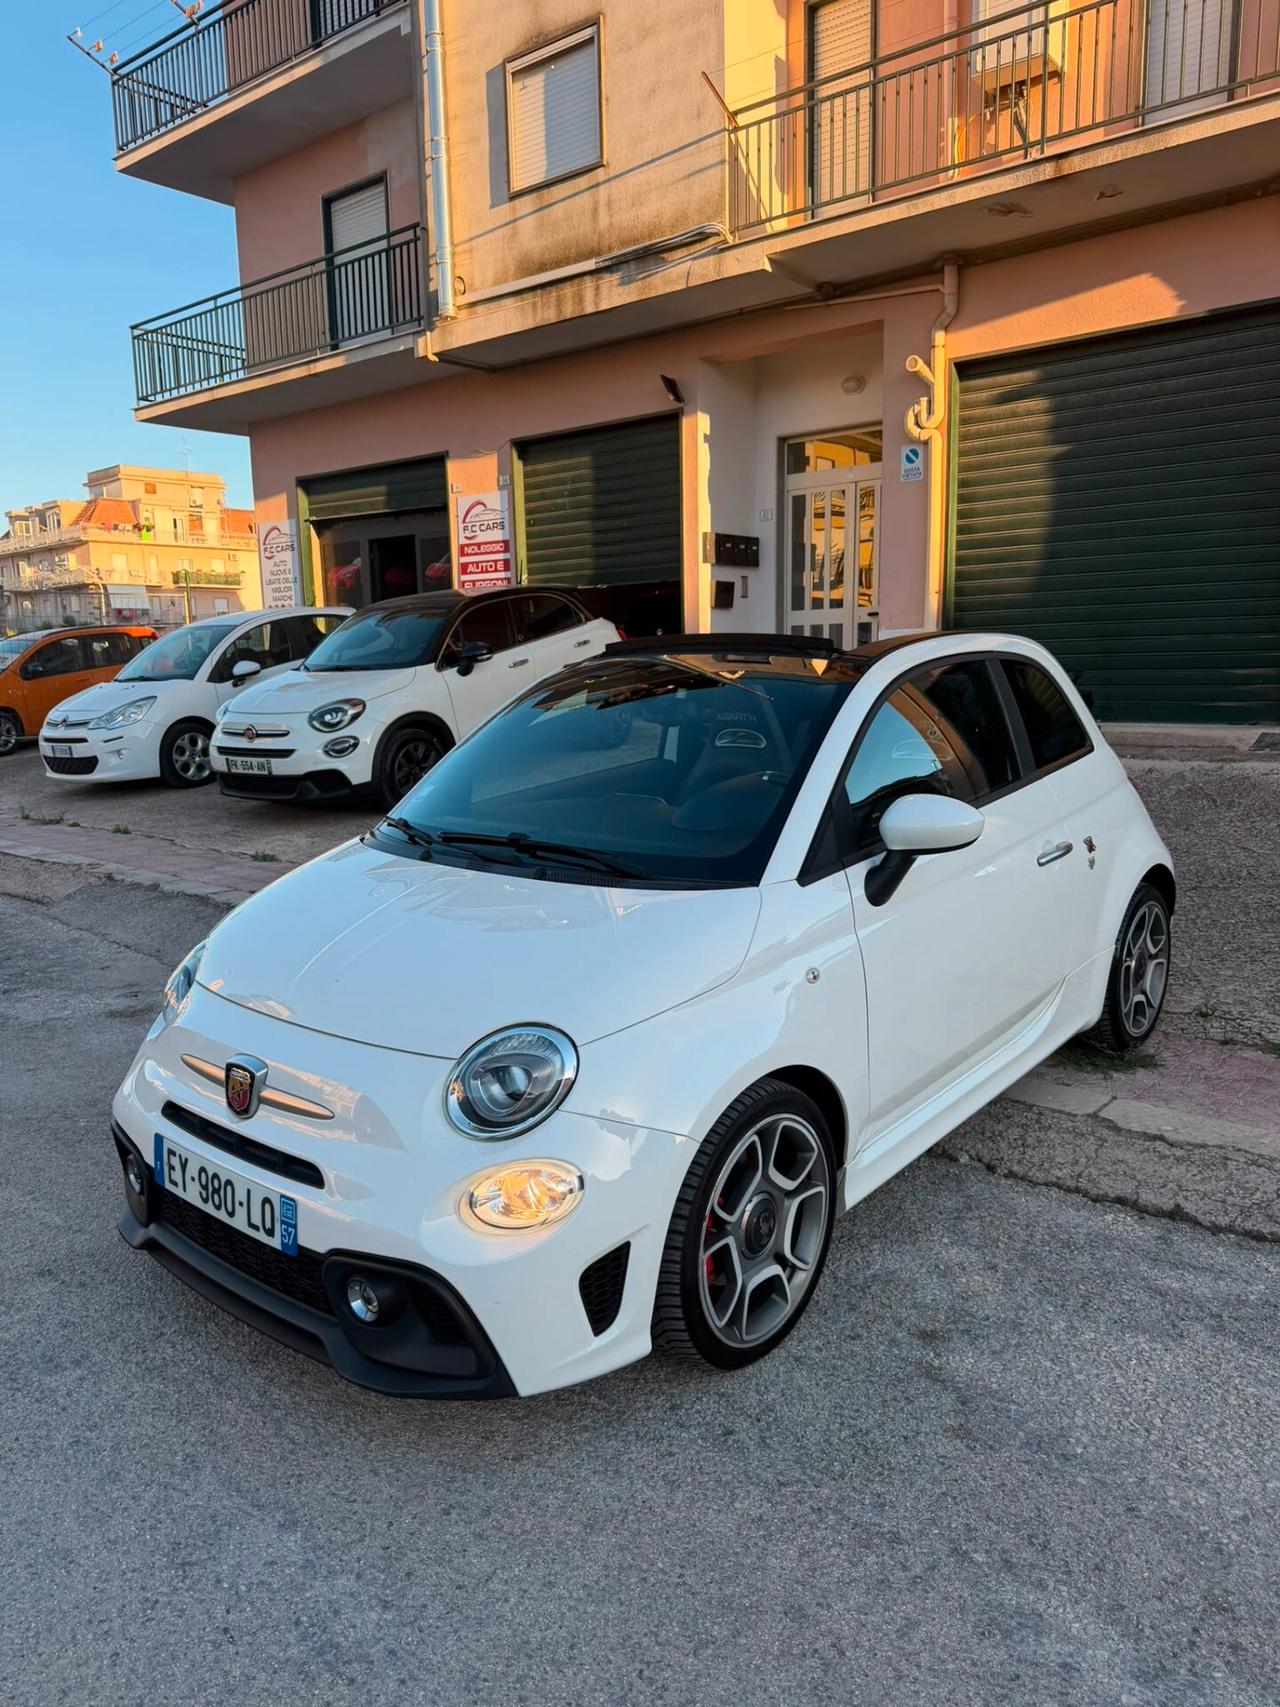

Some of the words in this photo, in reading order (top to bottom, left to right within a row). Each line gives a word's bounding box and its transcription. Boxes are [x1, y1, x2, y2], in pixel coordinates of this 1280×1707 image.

[463, 525, 477, 534] F.C
[479, 521, 505, 532] CARS
[264, 546, 275, 555] F.C
[275, 544, 295, 553] CARS
[464, 543, 505, 554] NOLEGGIO
[466, 561, 496, 573] AUTO
[497, 561, 505, 570] E
[167, 1147, 275, 1239] EY-980-LQ
[281, 1224, 295, 1246] 57
